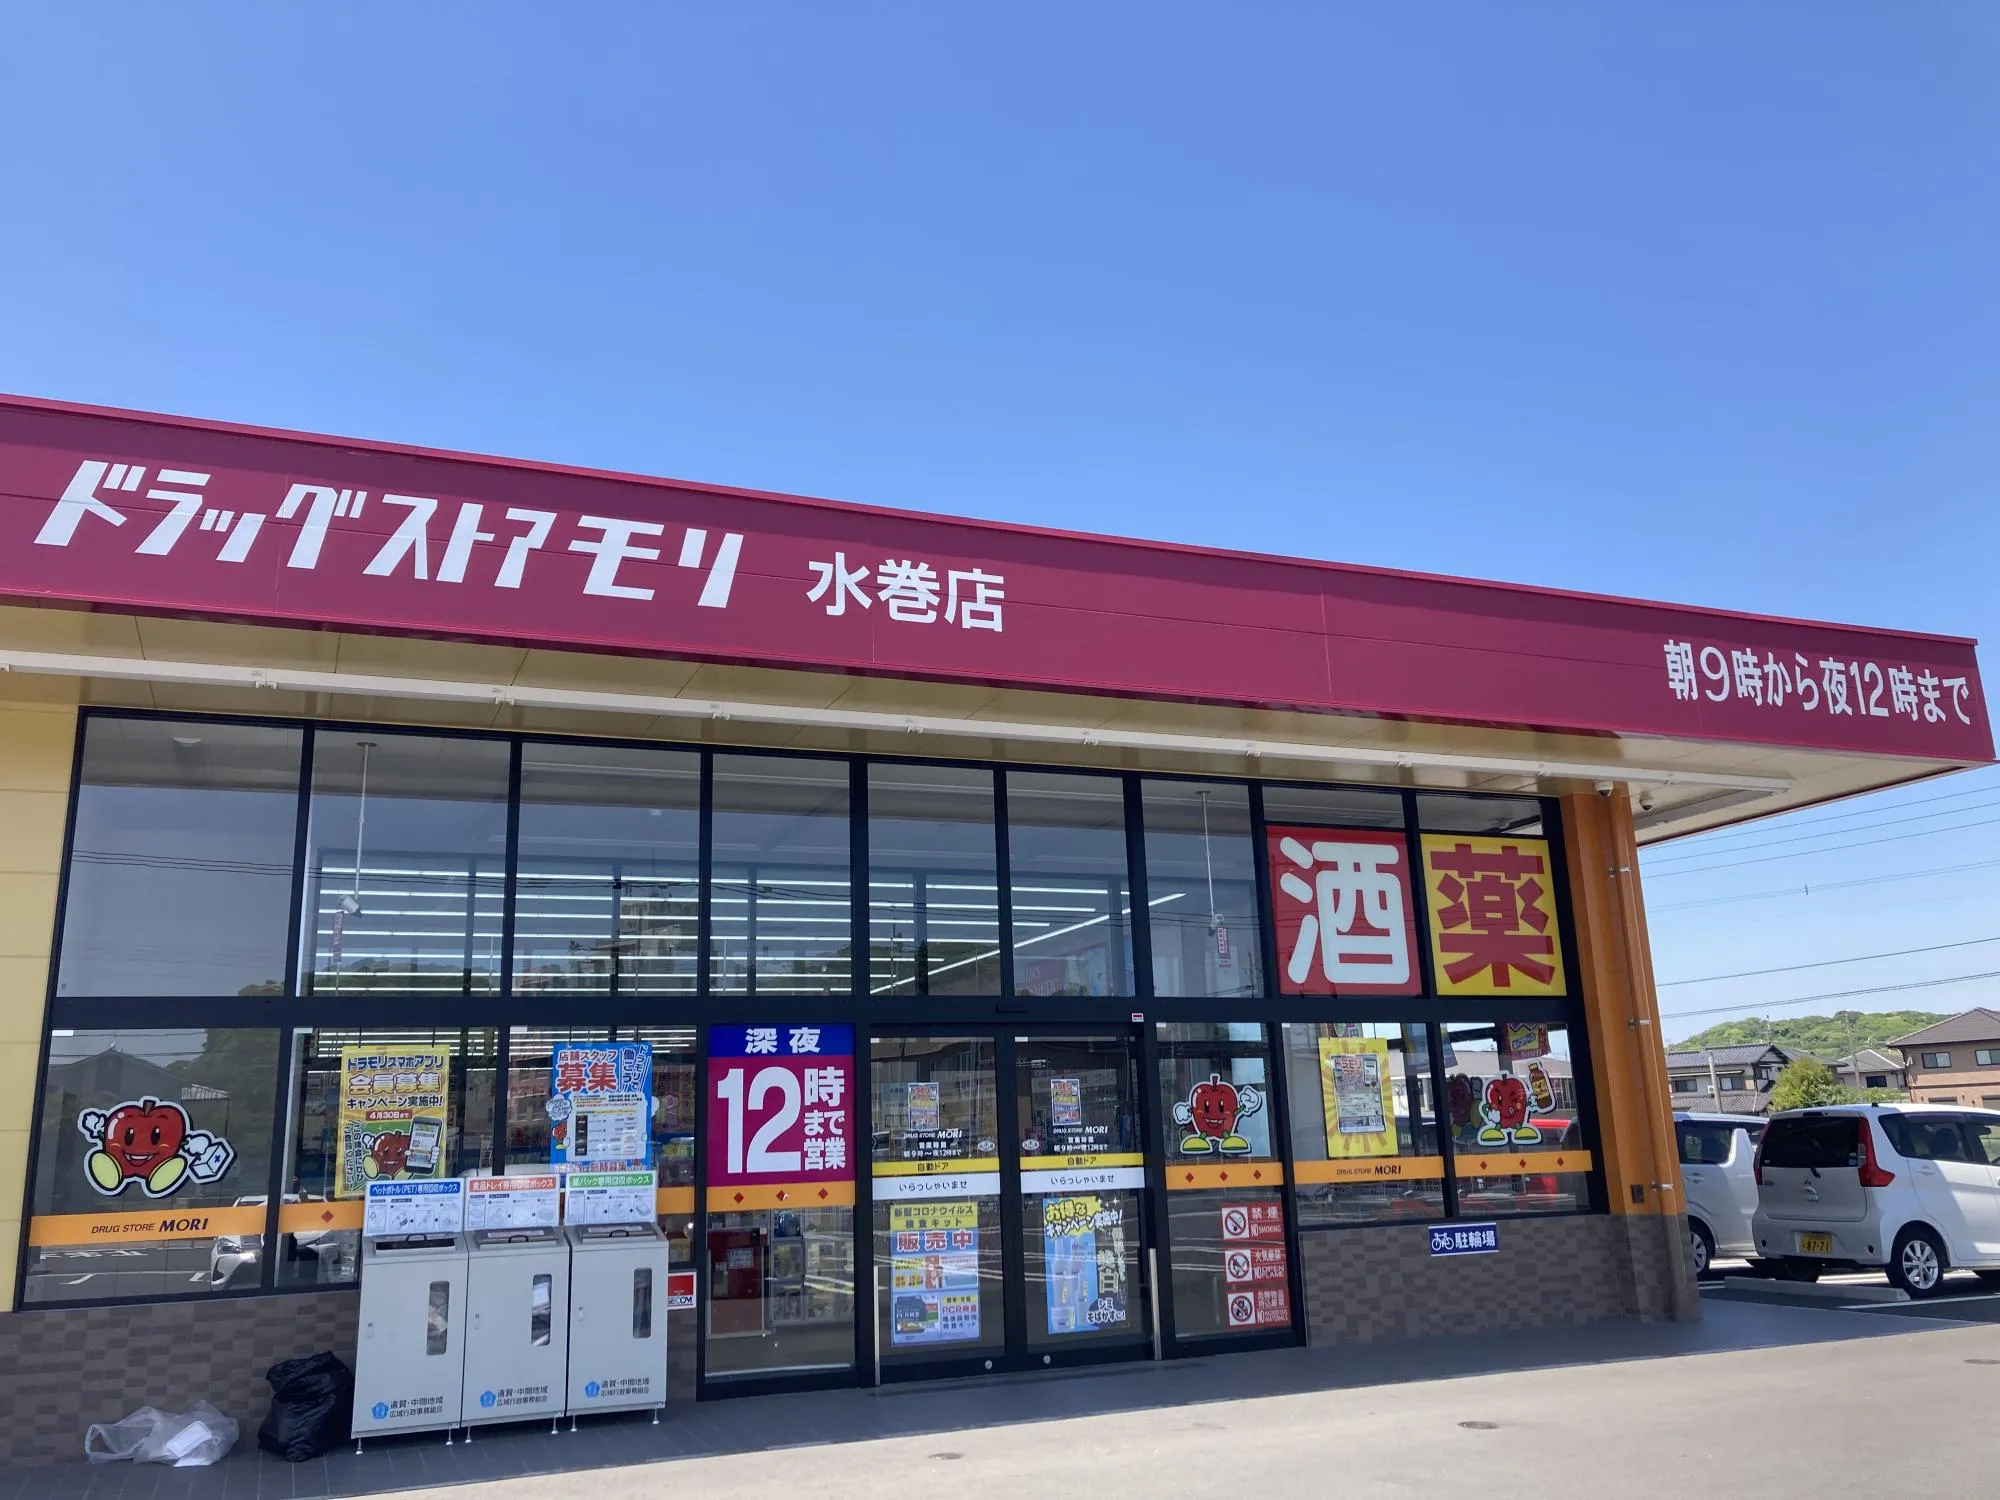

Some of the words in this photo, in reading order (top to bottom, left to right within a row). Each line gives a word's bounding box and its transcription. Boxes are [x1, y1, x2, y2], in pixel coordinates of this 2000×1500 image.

[35, 460, 743, 608] ドラッグストアモリ
[806, 551, 1005, 632] 水巻店
[1664, 639, 1970, 725] 朝9時から夜12時まで
[1280, 836, 1410, 984] 酒
[1430, 843, 1556, 988] 薬
[745, 1027, 820, 1054] 深夜
[347, 1055, 444, 1071] ドラモリスマホアプリ
[560, 1051, 617, 1061] 店舗スタッフ
[349, 1072, 441, 1095] 会員募集
[557, 1063, 617, 1091] 募集
[804, 1109, 845, 1136] まで
[1085, 1126, 1108, 1134] MORI
[937, 1130, 962, 1139] MORI
[804, 1137, 846, 1171] 営業
[1067, 1156, 1097, 1165] 自動ドア
[917, 1162, 949, 1172] 自動ドア
[1374, 1165, 1401, 1175] MORI
[899, 1180, 967, 1191] いらっしゃいませ
[1051, 1174, 1114, 1184] いらっしゃいませ
[1045, 1200, 1087, 1220] お得な
[1251, 1206, 1279, 1219] 禁煙
[91, 1225, 121, 1235] DRUG
[123, 1223, 155, 1233] STORE
[158, 1218, 208, 1233] MORI
[905, 1218, 963, 1229] 検査キット
[1250, 1223, 1258, 1237] NO
[897, 1229, 973, 1251] 販売中
[1454, 1231, 1495, 1248] 駐輪場
